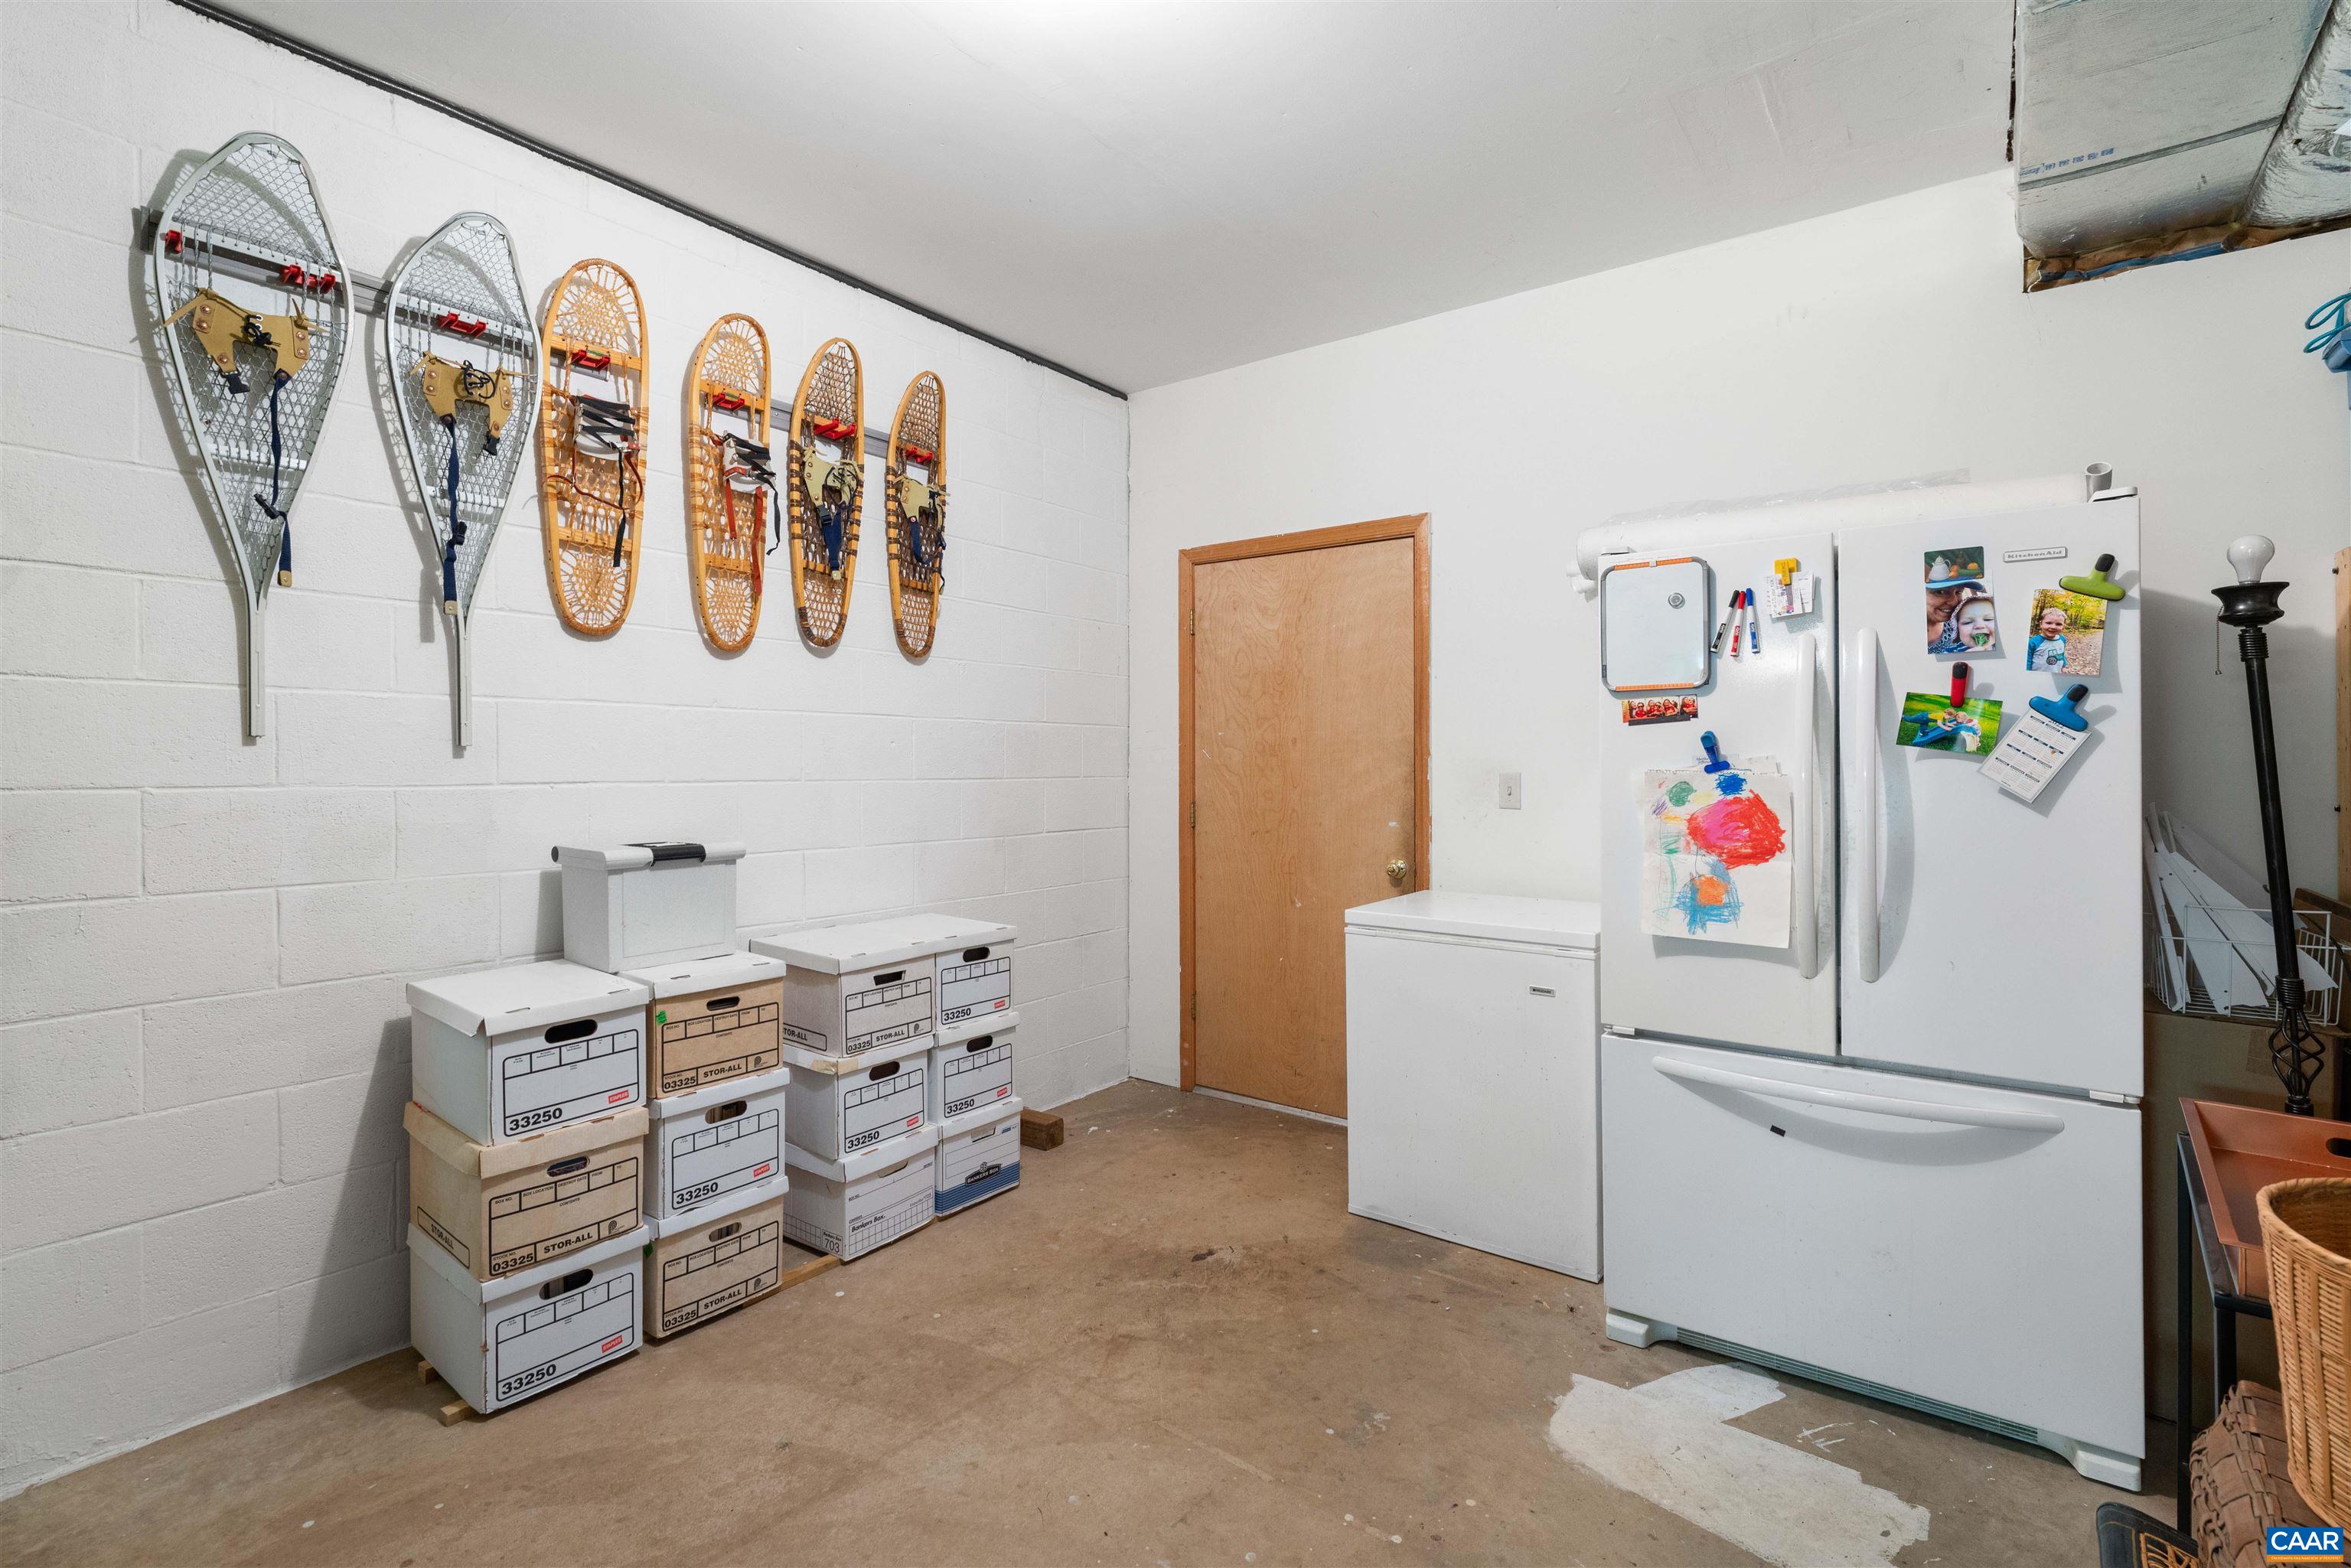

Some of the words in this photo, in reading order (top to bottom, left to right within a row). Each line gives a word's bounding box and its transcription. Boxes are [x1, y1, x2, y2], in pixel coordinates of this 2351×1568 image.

[2007, 550, 2062, 559] KitchenAid
[944, 1007, 972, 1022] 33250
[783, 1027, 808, 1042] TOR-ALL
[876, 1029, 905, 1042] STOR-ALL
[848, 1040, 871, 1052] 03325
[703, 1063, 742, 1078] STOR-ALL
[664, 1076, 696, 1090] 03325
[609, 1090, 629, 1103] STAPLES
[947, 1098, 975, 1114] 33250
[508, 1107, 563, 1132] 33250
[847, 1130, 880, 1149] 33250
[676, 1182, 719, 1205] 33250
[431, 1223, 454, 1250] STOR-ALL
[543, 1231, 593, 1253] STOR-ALL
[824, 1237, 840, 1253] 703
[492, 1253, 534, 1273] 03325
[703, 1289, 742, 1310] STOR-ALL
[664, 1309, 697, 1328] 03325
[602, 1335, 623, 1352] STAPLES
[501, 1364, 557, 1396] 33250
